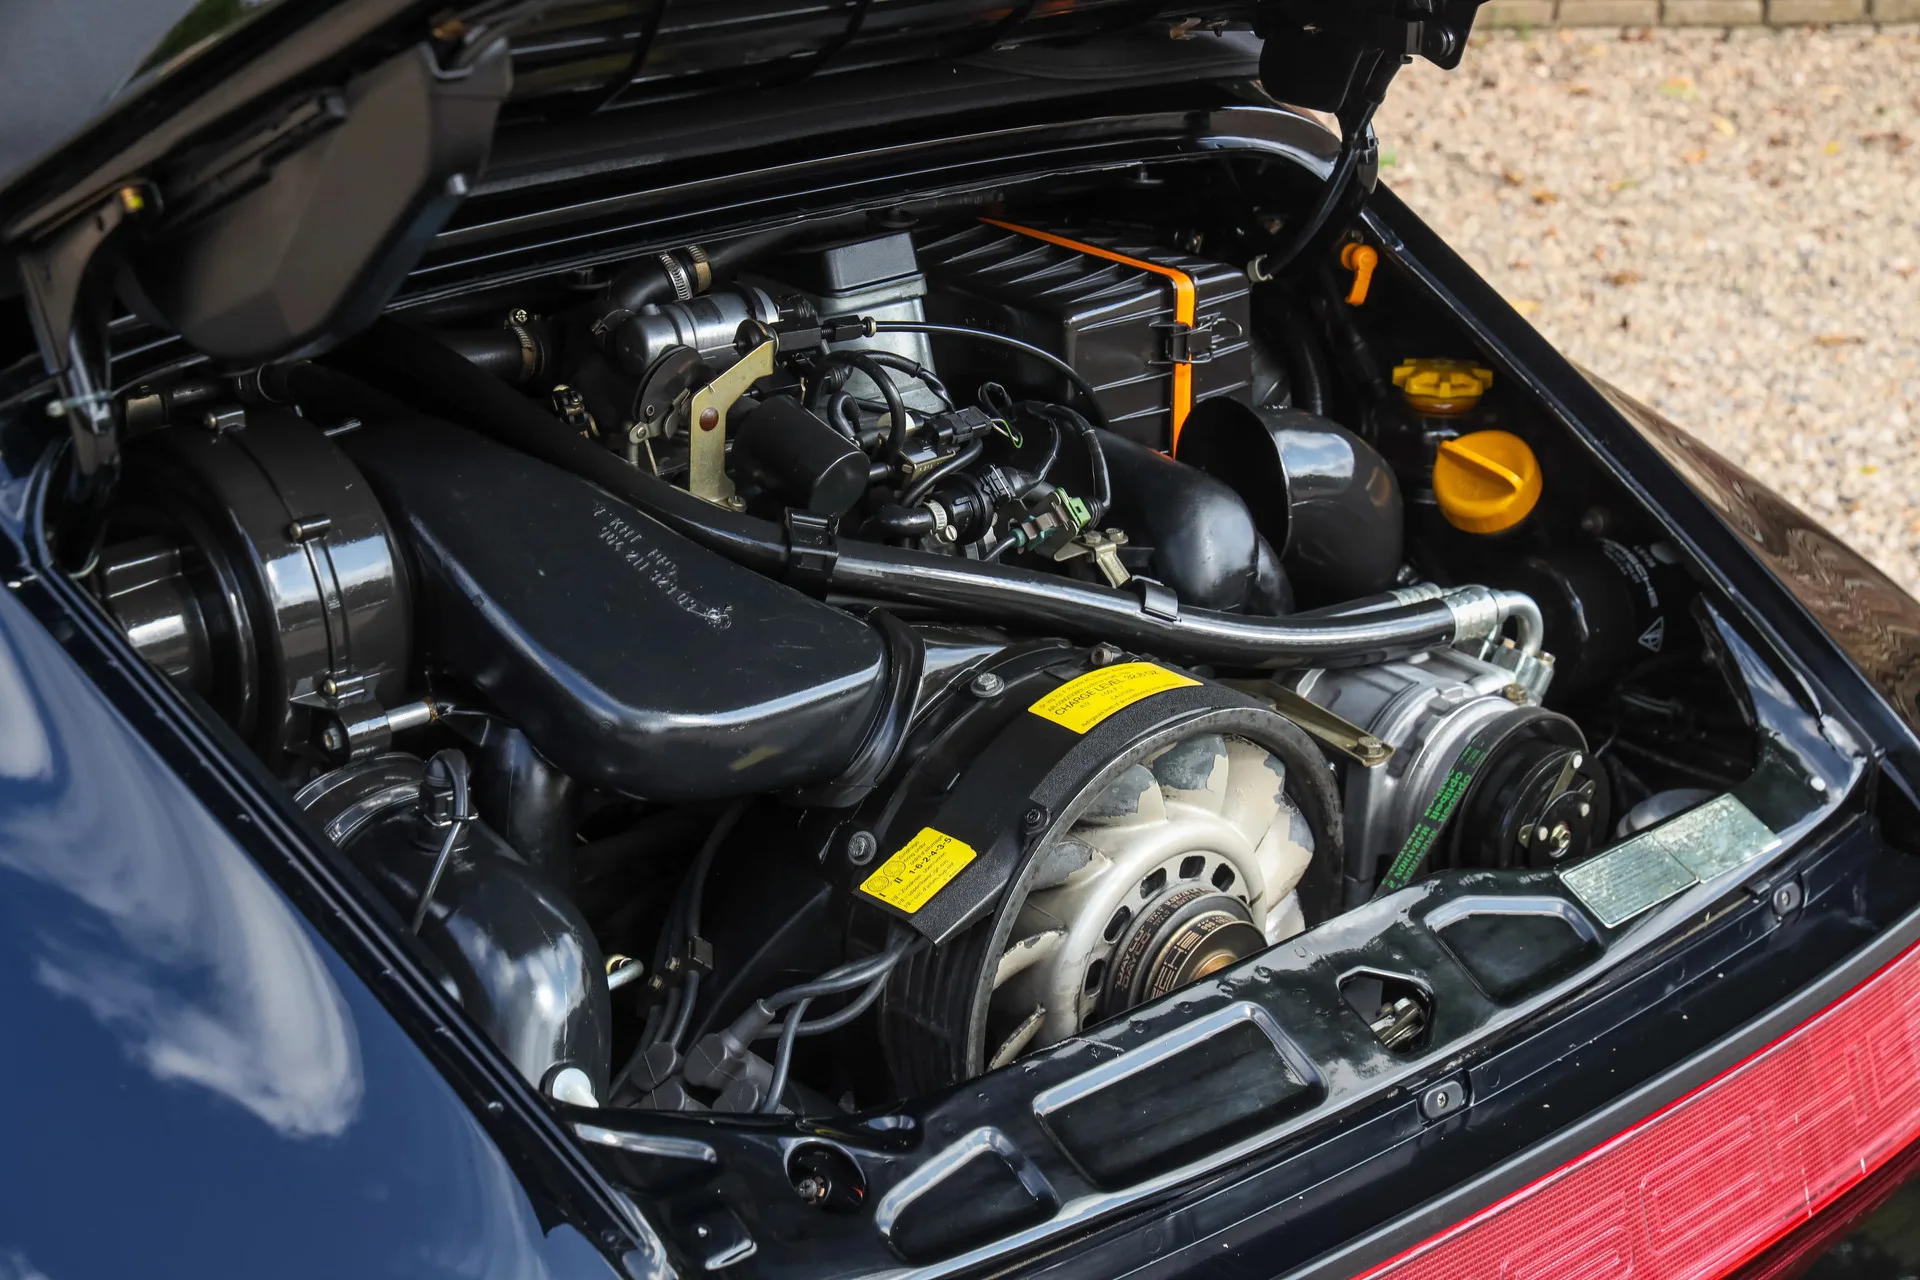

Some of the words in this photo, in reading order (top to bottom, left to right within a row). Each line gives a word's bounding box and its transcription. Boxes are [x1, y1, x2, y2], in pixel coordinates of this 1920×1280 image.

[1053, 689, 1098, 716] CHARGE
[1092, 676, 1126, 692] LEVEL
[1429, 770, 1463, 820] optibelt
[908, 837, 952, 875] 1-6-2-4-3-5
[1394, 825, 1431, 879] MARATHON
